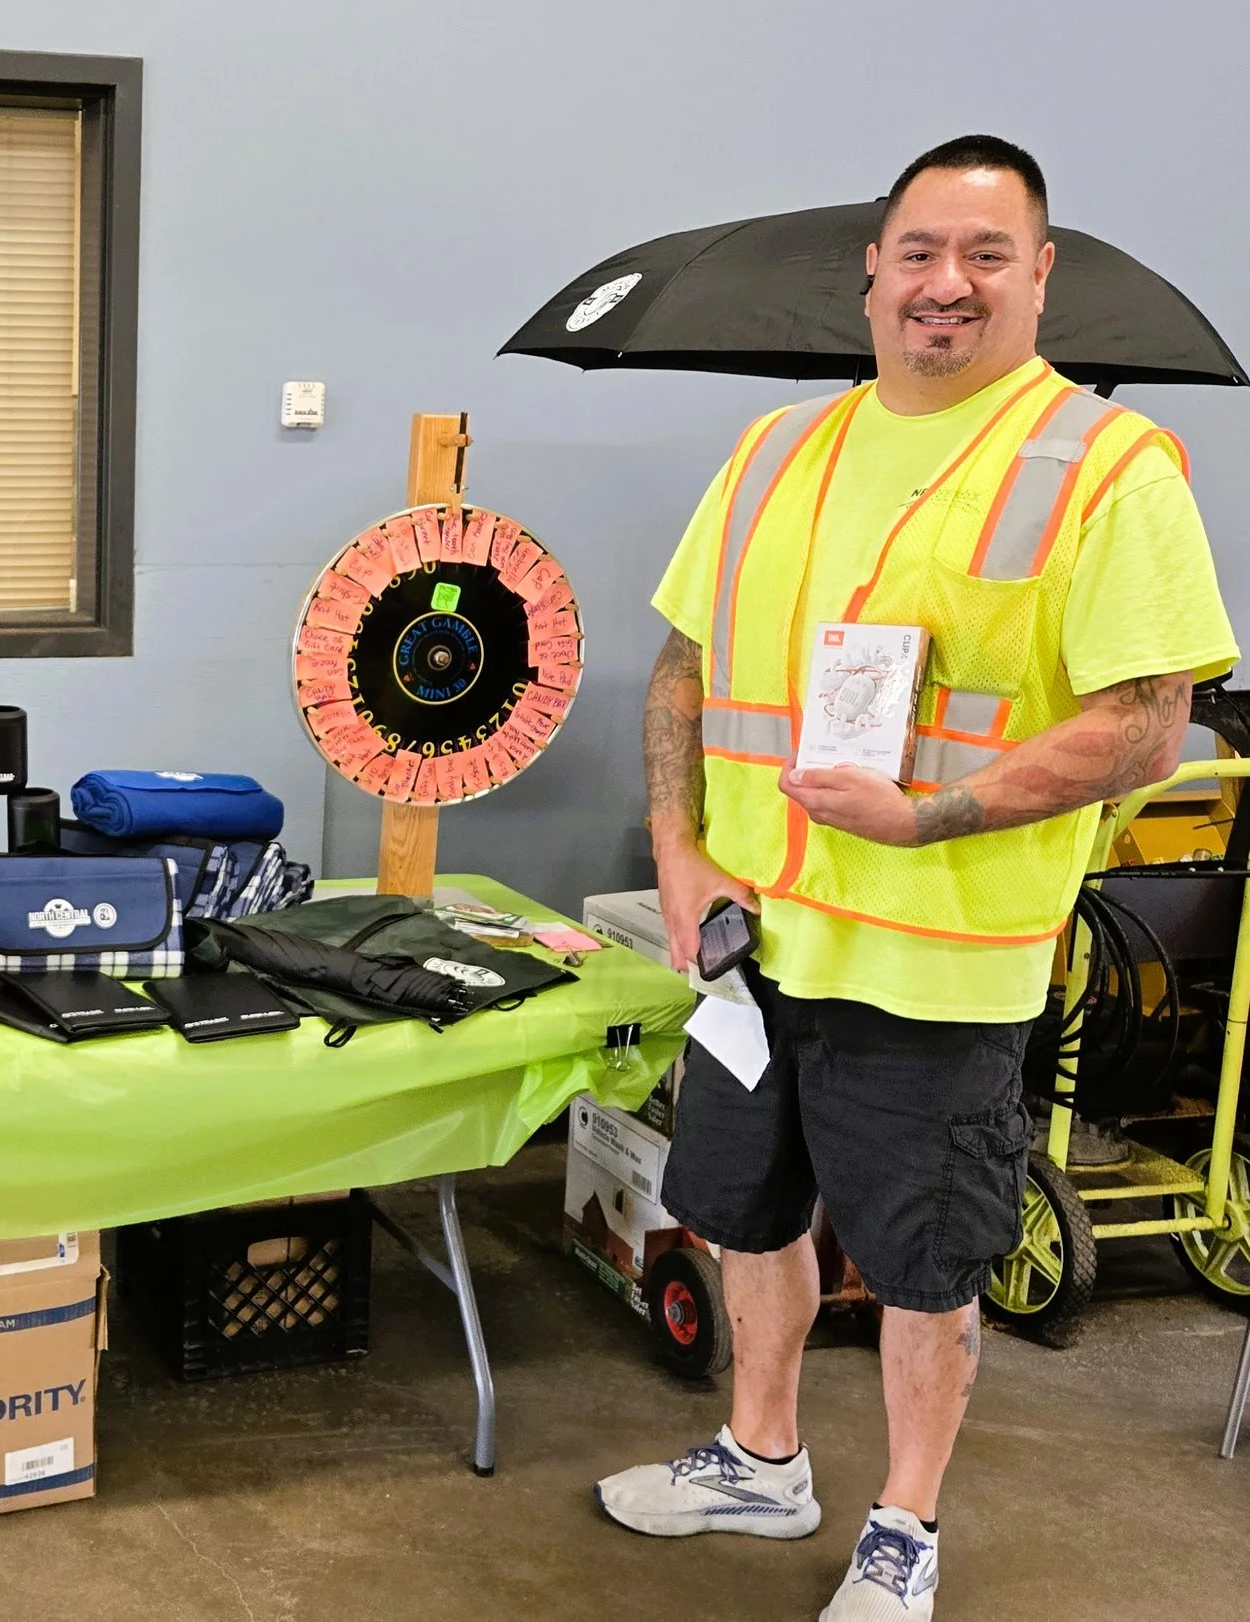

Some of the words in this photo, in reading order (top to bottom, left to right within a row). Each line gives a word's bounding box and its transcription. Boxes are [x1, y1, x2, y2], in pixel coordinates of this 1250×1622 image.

[532, 567, 551, 590] Cap
[399, 619, 428, 665] GREAT
[432, 617, 478, 653] GAMBLE
[902, 634, 911, 654] CLIP
[416, 684, 451, 699] MINI
[453, 678, 467, 693] 30
[526, 690, 554, 706] CANDY
[29, 911, 54, 921] NORTH
[56, 908, 90, 921] CENTRAL
[607, 927, 634, 950] 910953
[592, 1112, 618, 1138] 910953
